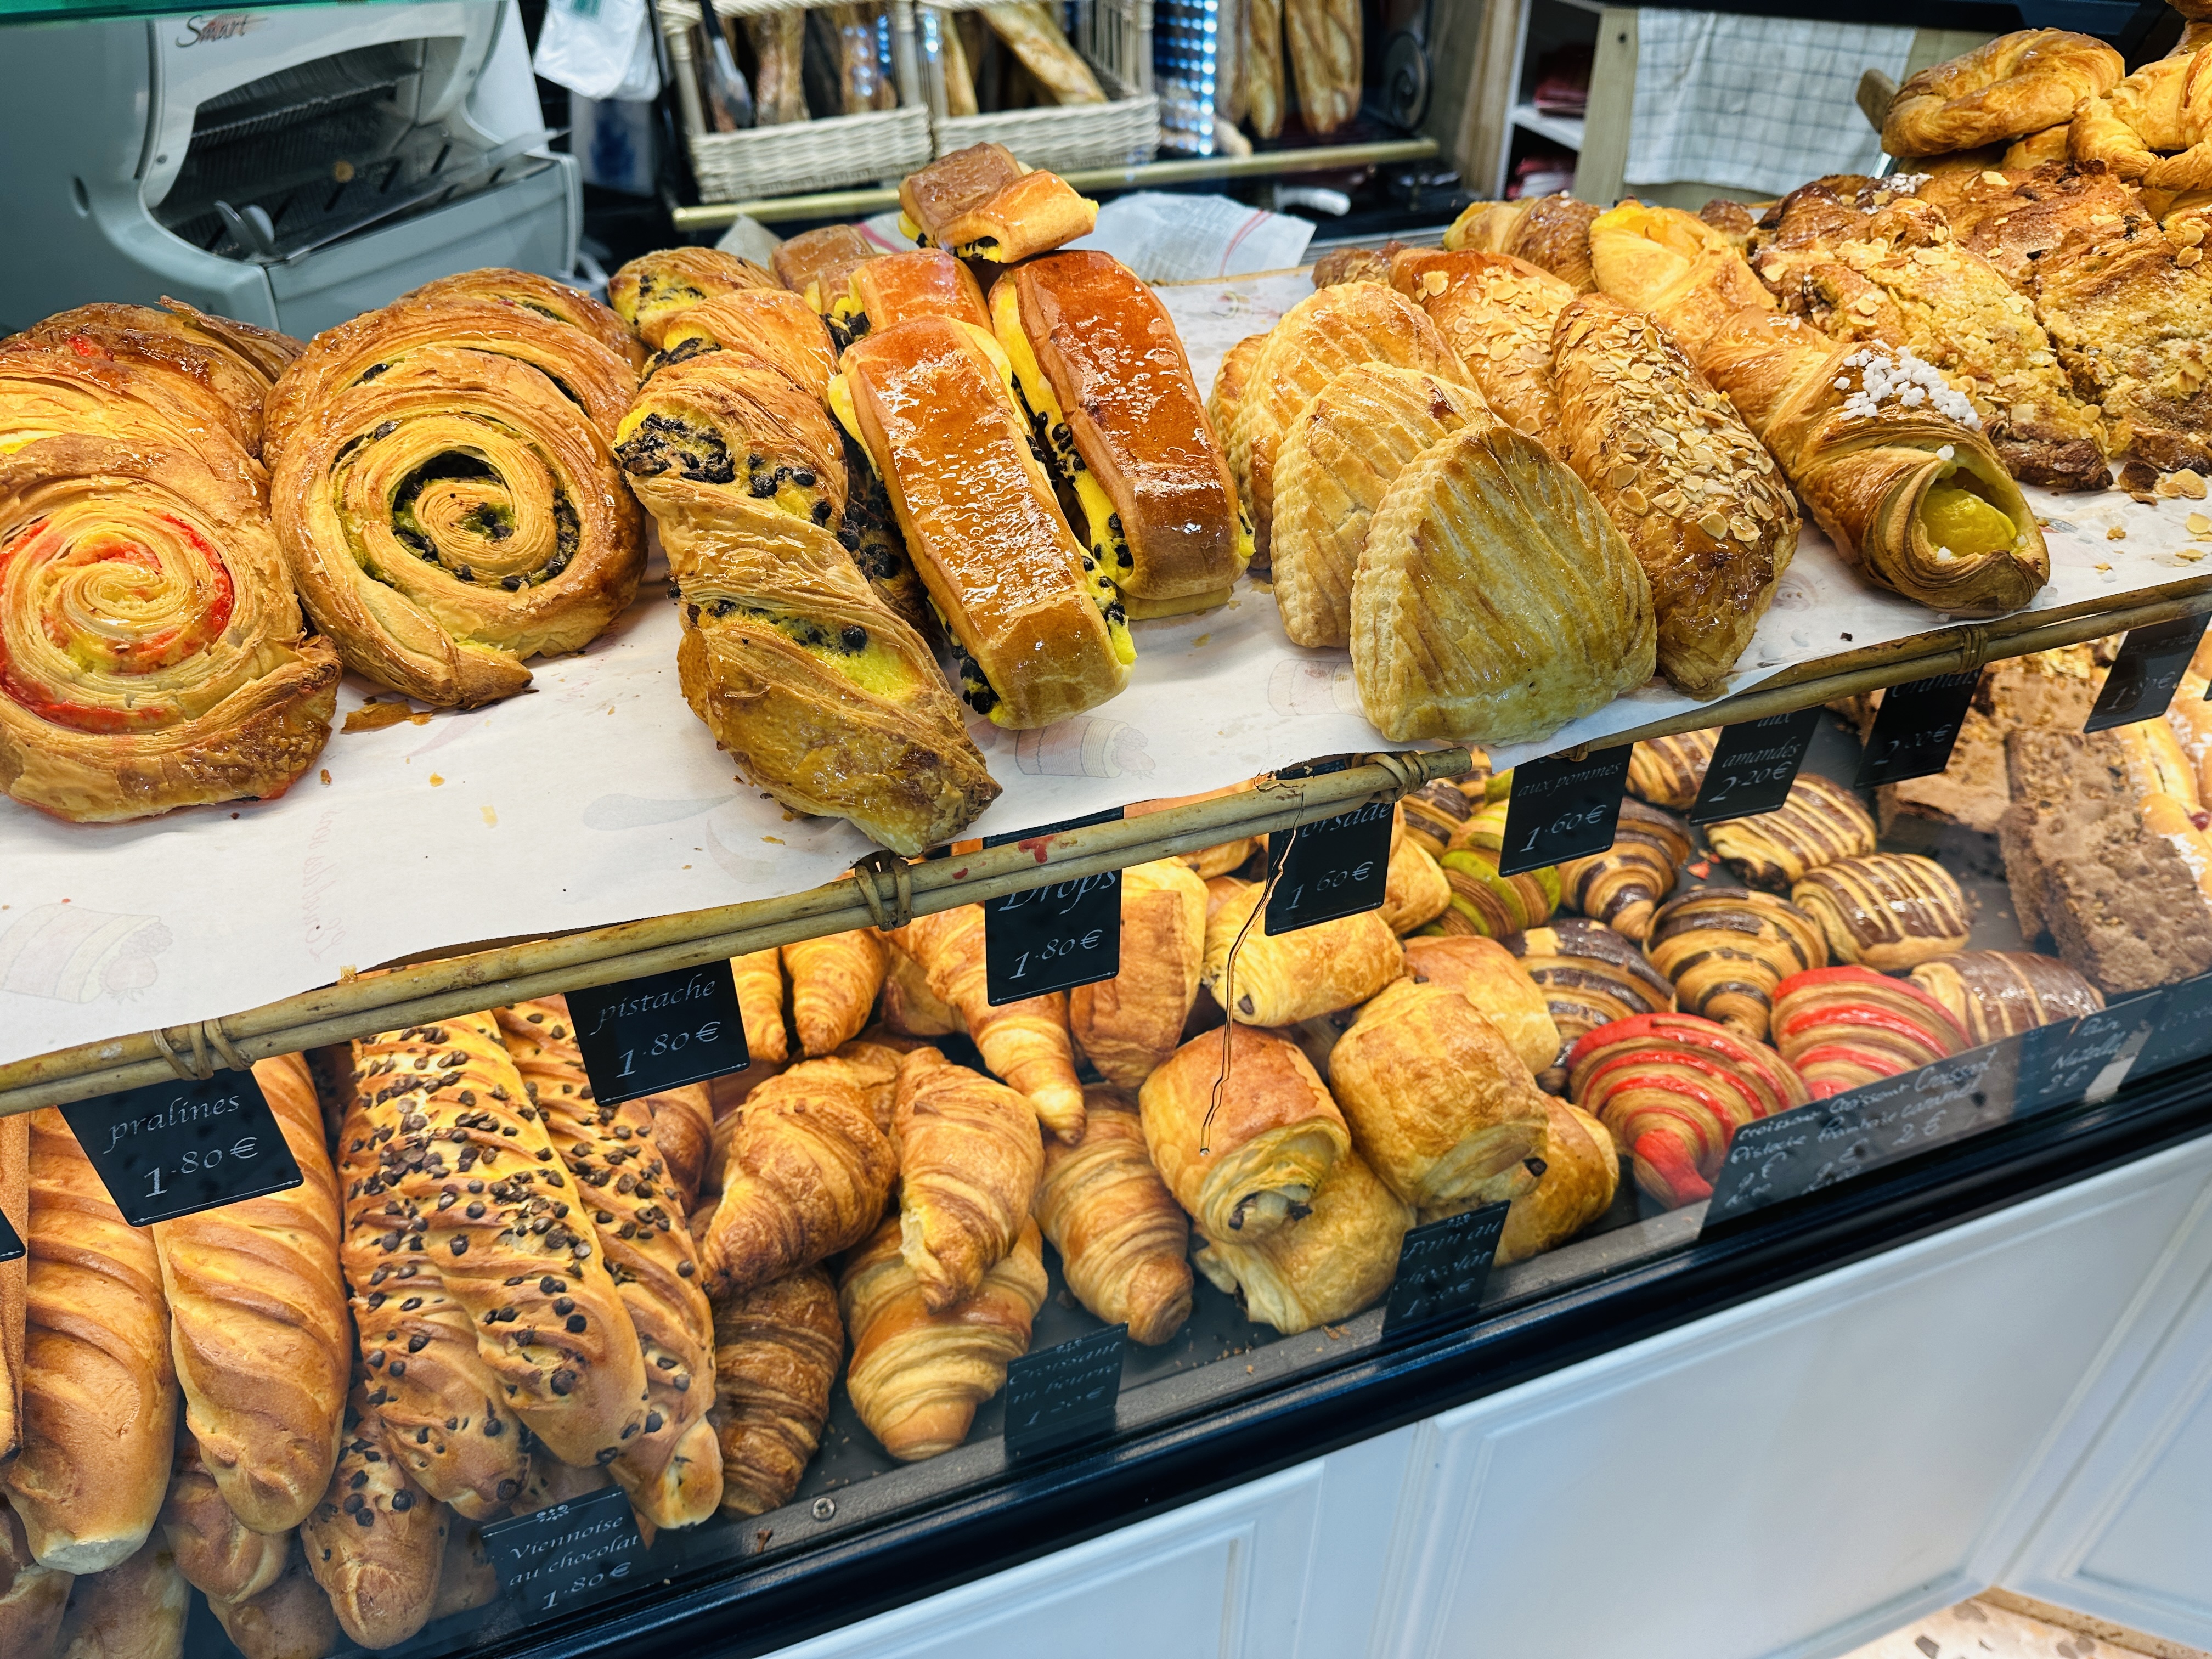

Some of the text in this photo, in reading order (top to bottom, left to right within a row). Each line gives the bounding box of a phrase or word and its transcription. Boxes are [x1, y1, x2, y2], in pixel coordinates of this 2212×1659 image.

[175, 14, 267, 48] Smart
[1722, 736, 1801, 768] amandes
[1517, 762, 1622, 797] aux pommes
[1281, 803, 1393, 839] orsade
[997, 868, 1116, 915] Drops
[589, 973, 716, 1036] pistache
[103, 1093, 240, 1155] pralines
[1466, 1220, 1502, 1240] au
[1008, 1340, 1122, 1386] Croissant
[1011, 1390, 1036, 1406] au
[509, 1515, 624, 1559] Viennoise
[509, 1533, 640, 1587] au chocolat
